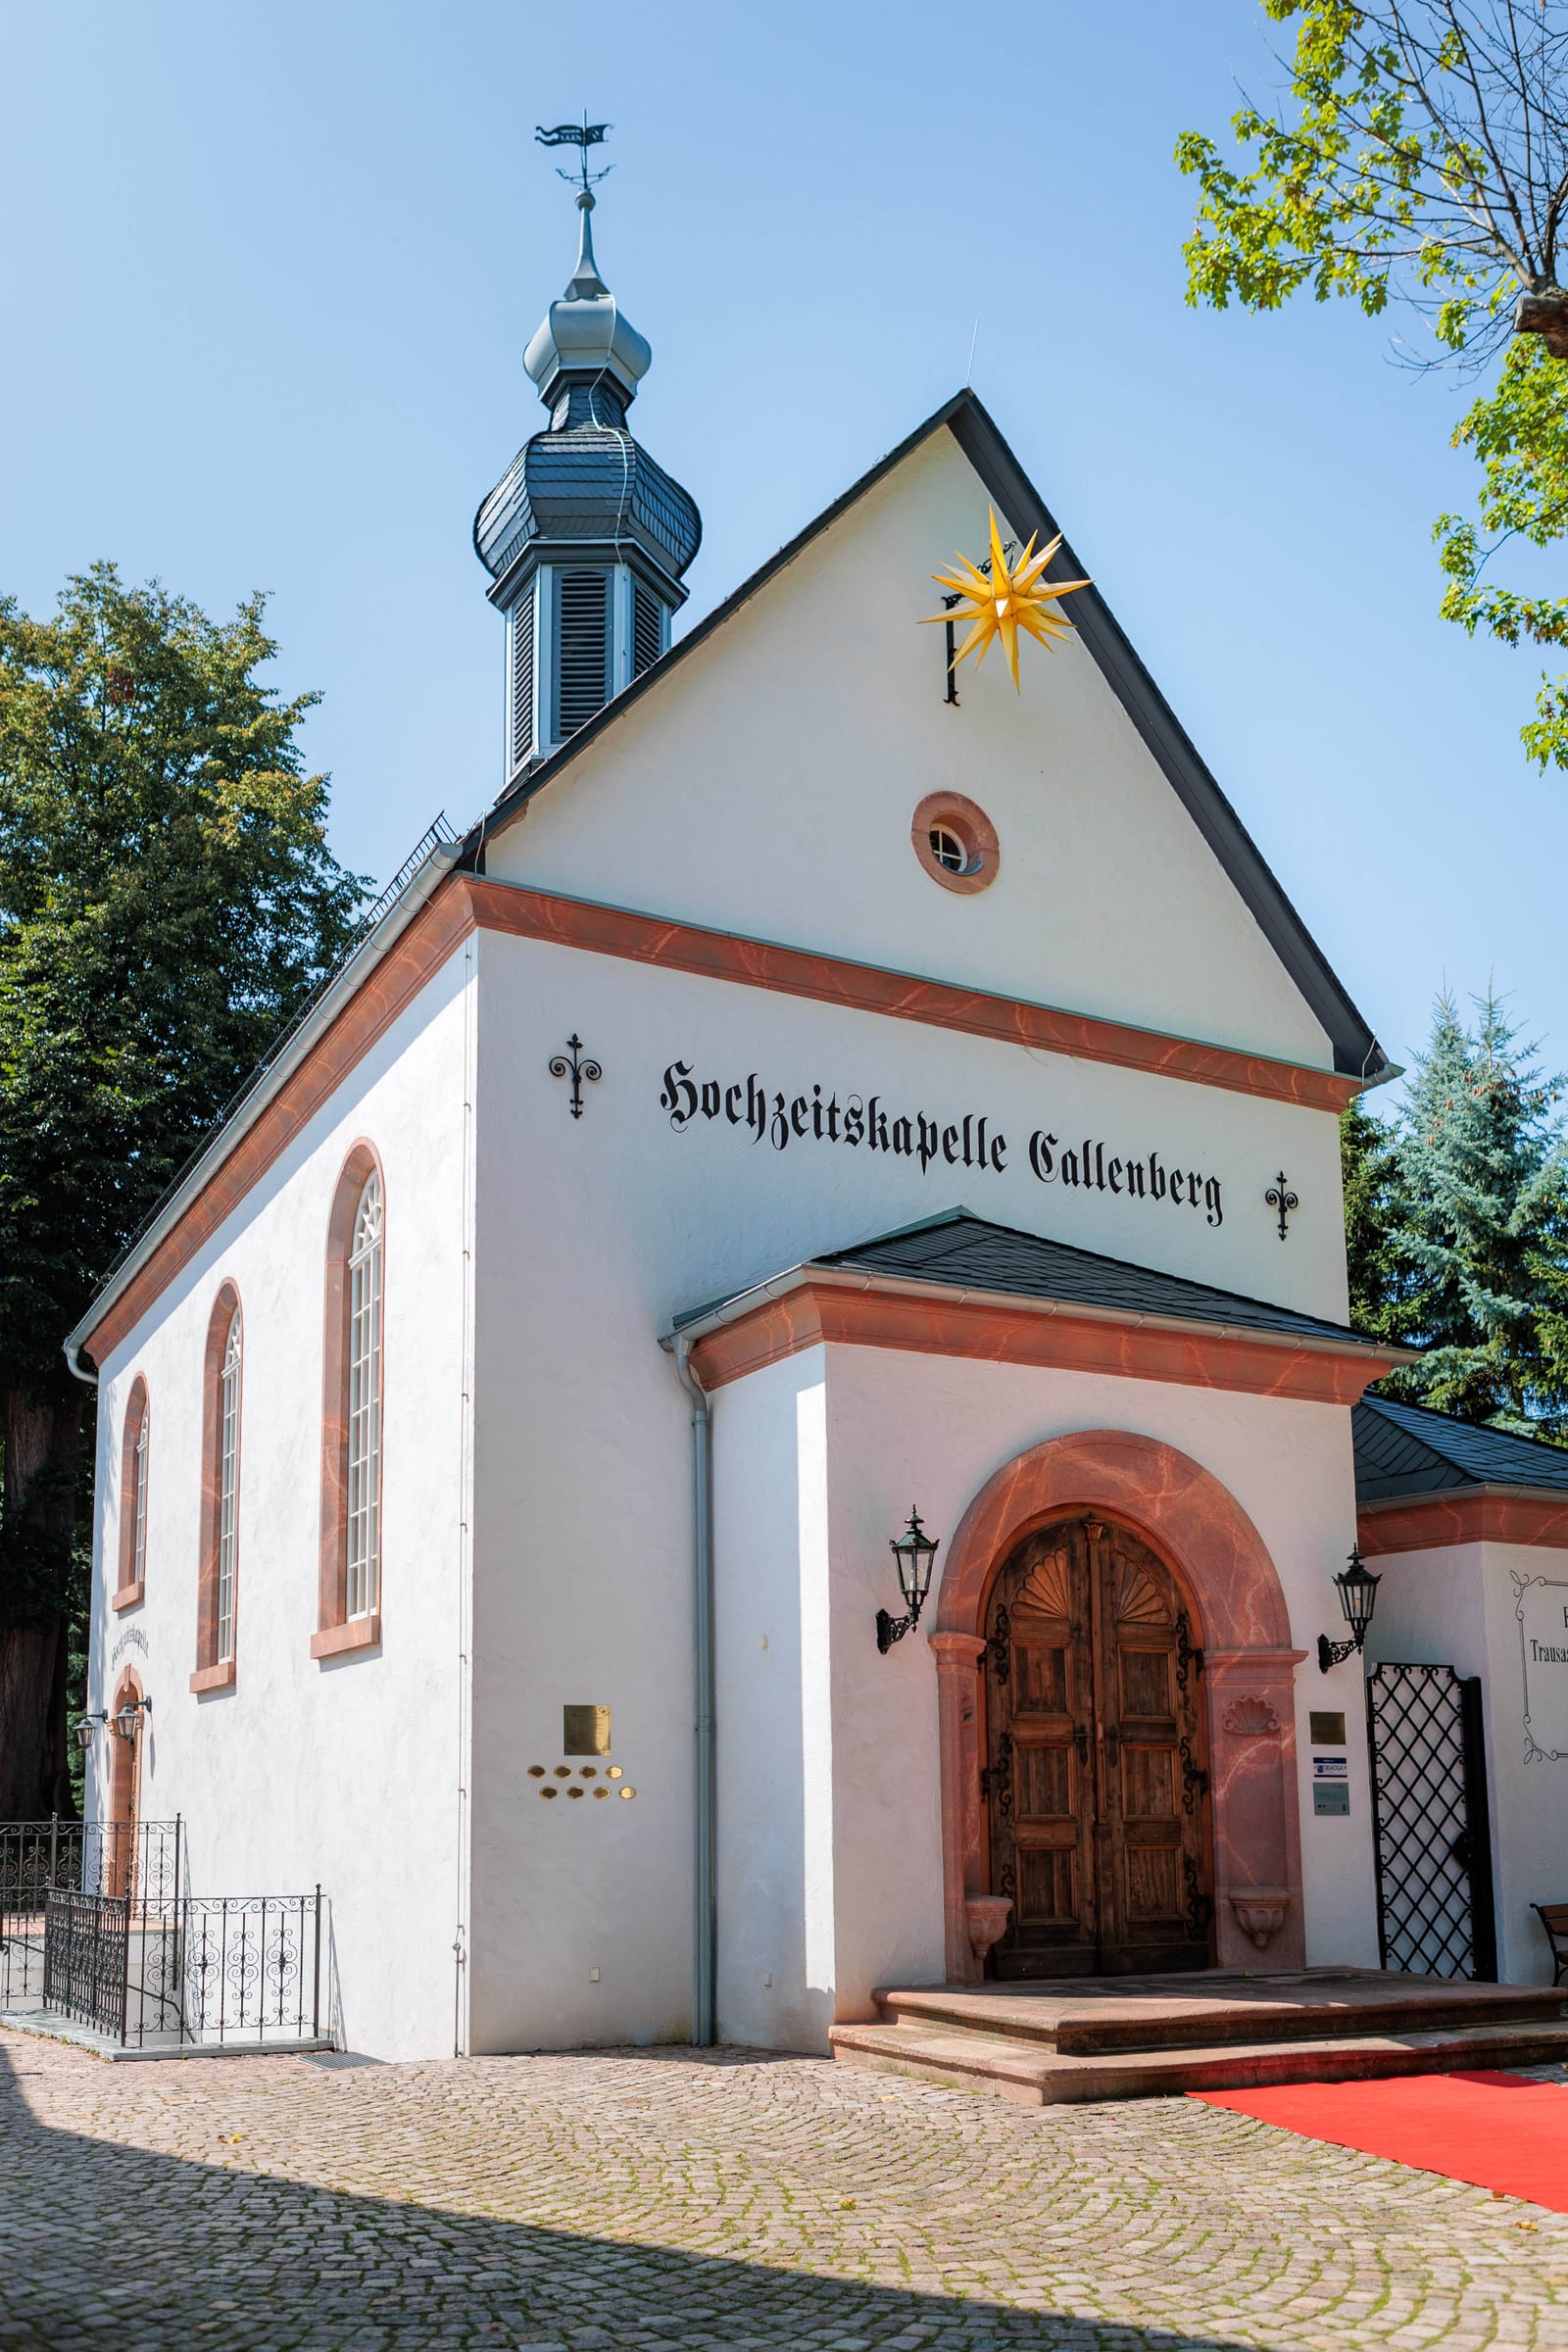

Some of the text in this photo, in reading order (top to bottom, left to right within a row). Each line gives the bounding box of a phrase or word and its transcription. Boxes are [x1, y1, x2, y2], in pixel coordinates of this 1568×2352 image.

[660, 1059, 1223, 1227] Hochzeitskapelle Callenberg
[1530, 1639, 1568, 1663] Trausa
